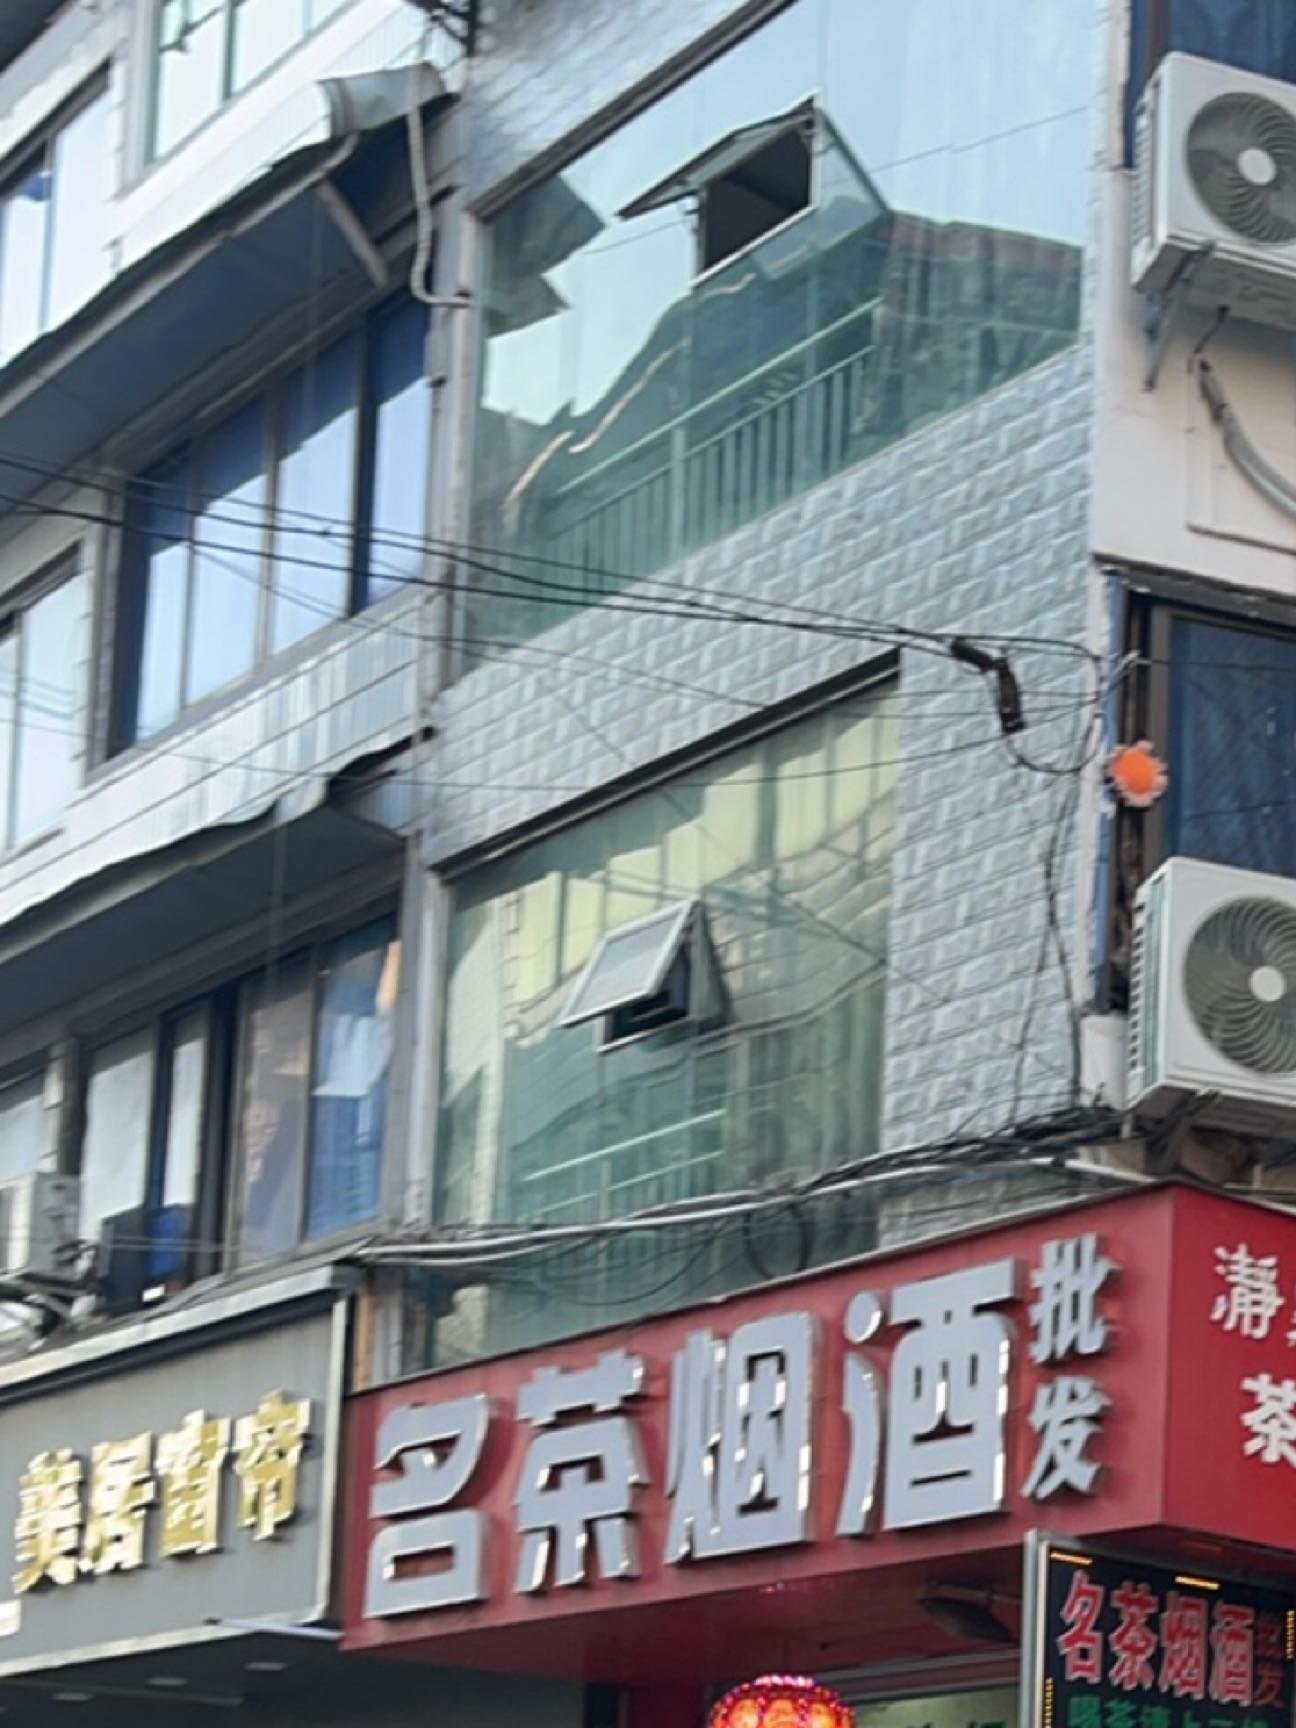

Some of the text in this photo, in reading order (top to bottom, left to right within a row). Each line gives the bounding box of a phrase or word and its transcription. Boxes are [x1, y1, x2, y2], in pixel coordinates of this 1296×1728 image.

[366, 1257, 1024, 1618] 名茶烟酒
[1022, 1233, 1116, 1502] 批发
